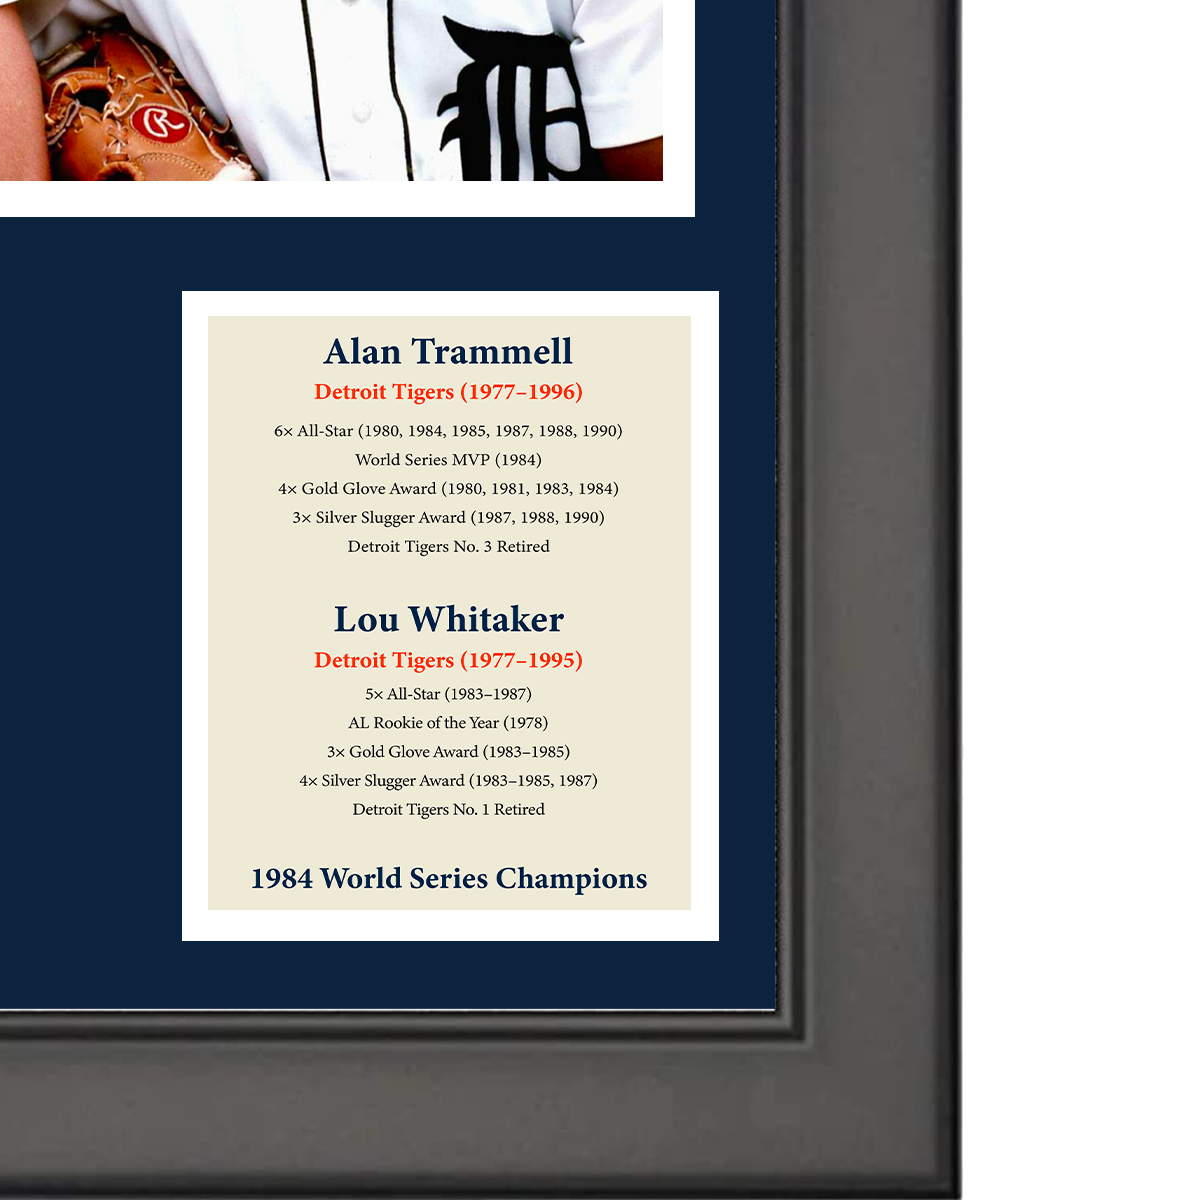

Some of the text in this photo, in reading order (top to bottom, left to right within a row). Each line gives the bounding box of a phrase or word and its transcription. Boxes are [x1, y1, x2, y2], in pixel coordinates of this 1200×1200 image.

[437, 15, 600, 181] D
[322, 336, 574, 365] Alan Trammell
[313, 383, 387, 401] Detroit
[391, 382, 455, 406] Tigers
[296, 423, 354, 438] All-Star
[358, 423, 403, 440] (1980,
[408, 424, 447, 439] 1984,
[452, 424, 491, 439] 1985,
[496, 424, 534, 439] 1987,
[539, 424, 578, 439] 1988,
[583, 423, 623, 441] 1990)
[354, 452, 542, 470] World Series MVP (1984)
[301, 481, 339, 496] Gold
[342, 481, 386, 496] Glove
[388, 481, 437, 495] Award
[441, 481, 487, 498] (1980,
[491, 482, 530, 497] 1981,
[535, 482, 574, 497] 1983,
[579, 481, 619, 498] 1984)
[315, 509, 358, 524] Silver
[360, 509, 416, 528] Slugger
[417, 509, 467, 524] Award
[470, 509, 516, 527] (1987,
[521, 511, 559, 526] 1988,
[564, 509, 605, 527] 1990)
[347, 539, 551, 557] Detroit Tigers No. 3 Retired
[333, 603, 565, 633] Lou Whitaker
[314, 651, 387, 669] Detroit
[391, 651, 455, 674] Tigers
[386, 686, 442, 701] All-Star
[347, 715, 549, 732] AL Rookie of the Year (1978)
[349, 744, 386, 759] Gold
[388, 744, 431, 759] Glove
[432, 744, 479, 759] Award
[321, 773, 362, 788] Silver
[364, 773, 417, 792] Slugger
[418, 773, 466, 787] Award
[559, 772, 598, 790] 1987)
[352, 801, 546, 820] Detroit Tigers No. 1 Retired
[251, 865, 648, 896] 1984 World Series Champions
